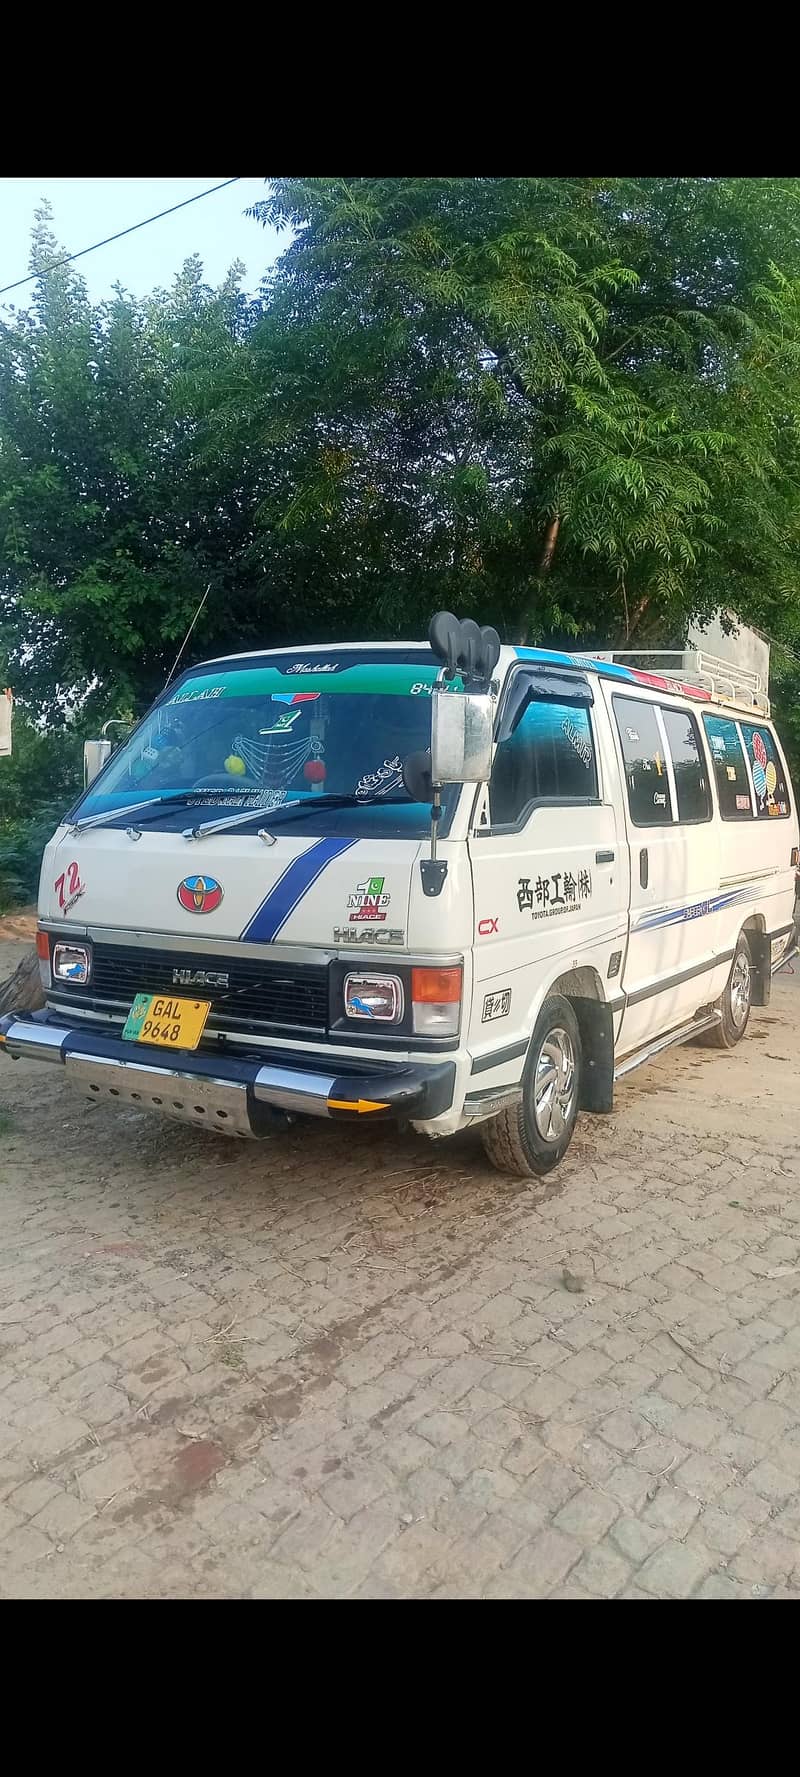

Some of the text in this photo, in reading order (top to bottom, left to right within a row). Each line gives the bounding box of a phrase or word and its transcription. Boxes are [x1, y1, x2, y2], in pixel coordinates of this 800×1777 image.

[346, 893, 391, 908] NINE
[333, 927, 405, 945] HIACE
[478, 917, 500, 936] CX
[172, 968, 230, 988] HIACE
[153, 1000, 182, 1019] GAL
[142, 1020, 181, 1041] 9648
